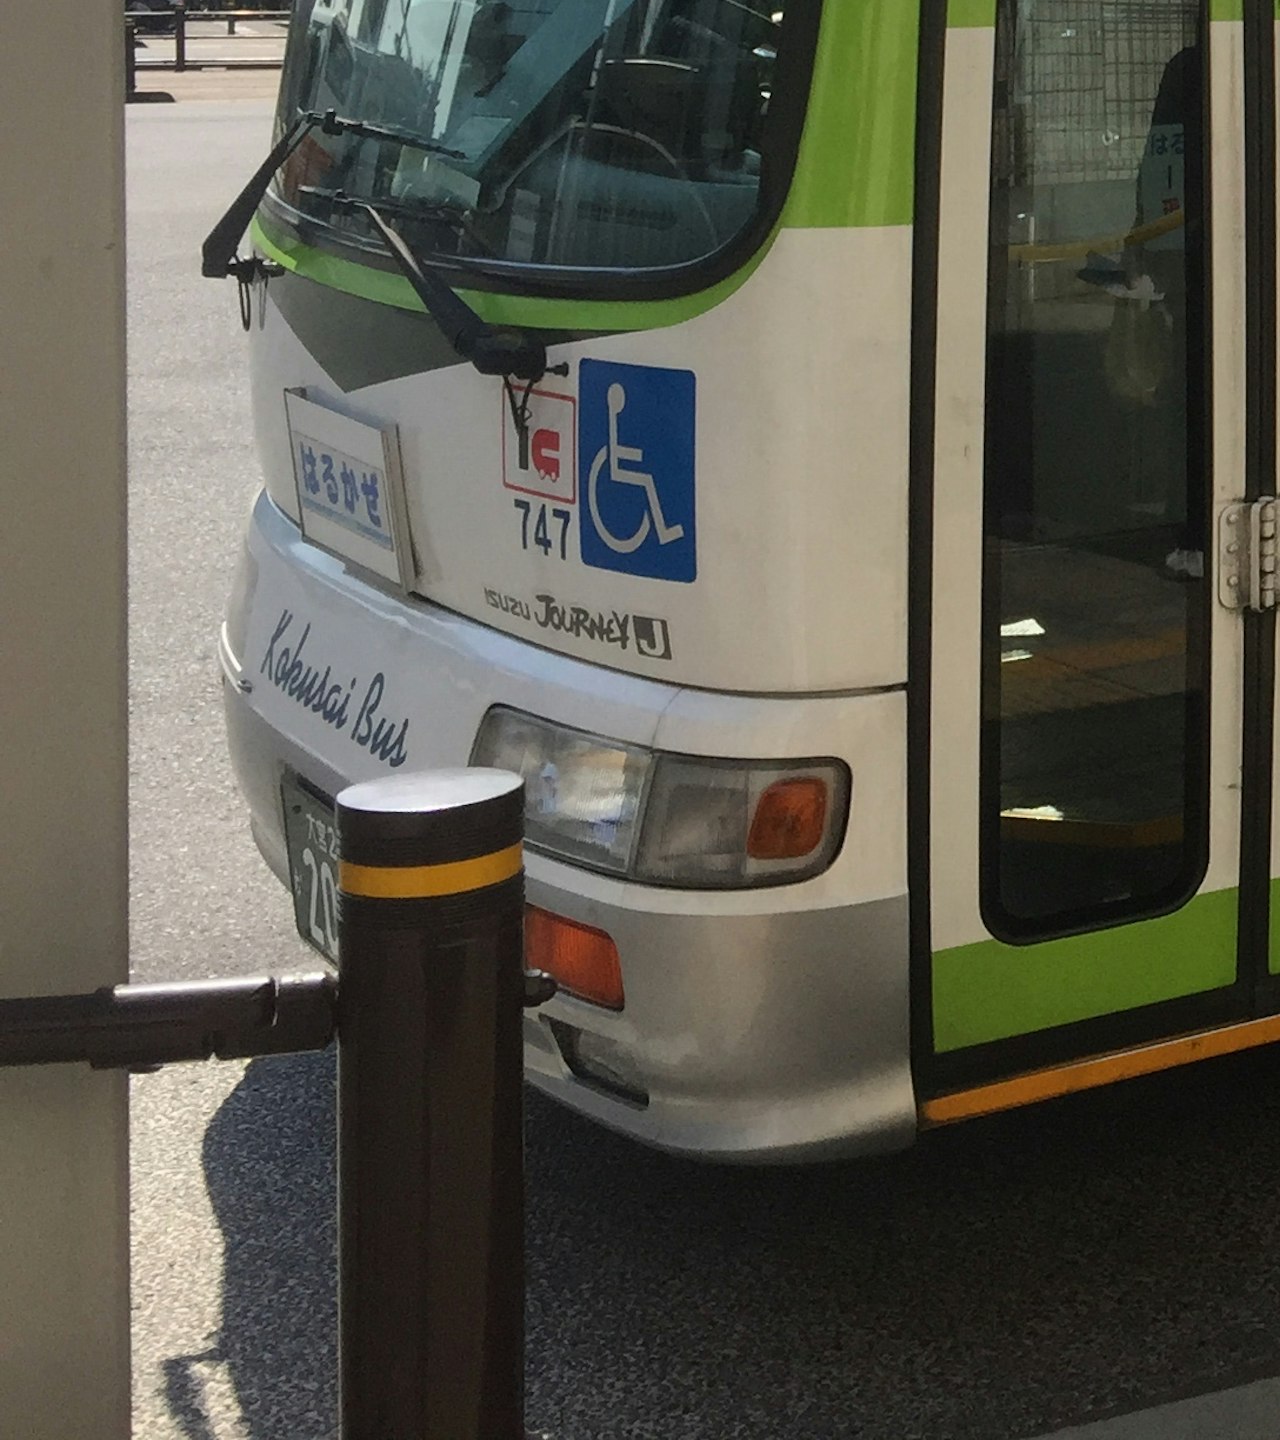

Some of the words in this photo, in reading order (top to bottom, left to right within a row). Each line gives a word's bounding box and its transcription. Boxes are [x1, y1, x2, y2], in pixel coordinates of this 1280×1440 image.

[299, 440, 382, 529] はるかぜ
[513, 498, 571, 561] 747
[483, 587, 531, 621] ISUZU
[260, 609, 357, 730] Kokusai
[349, 672, 409, 768] Bus
